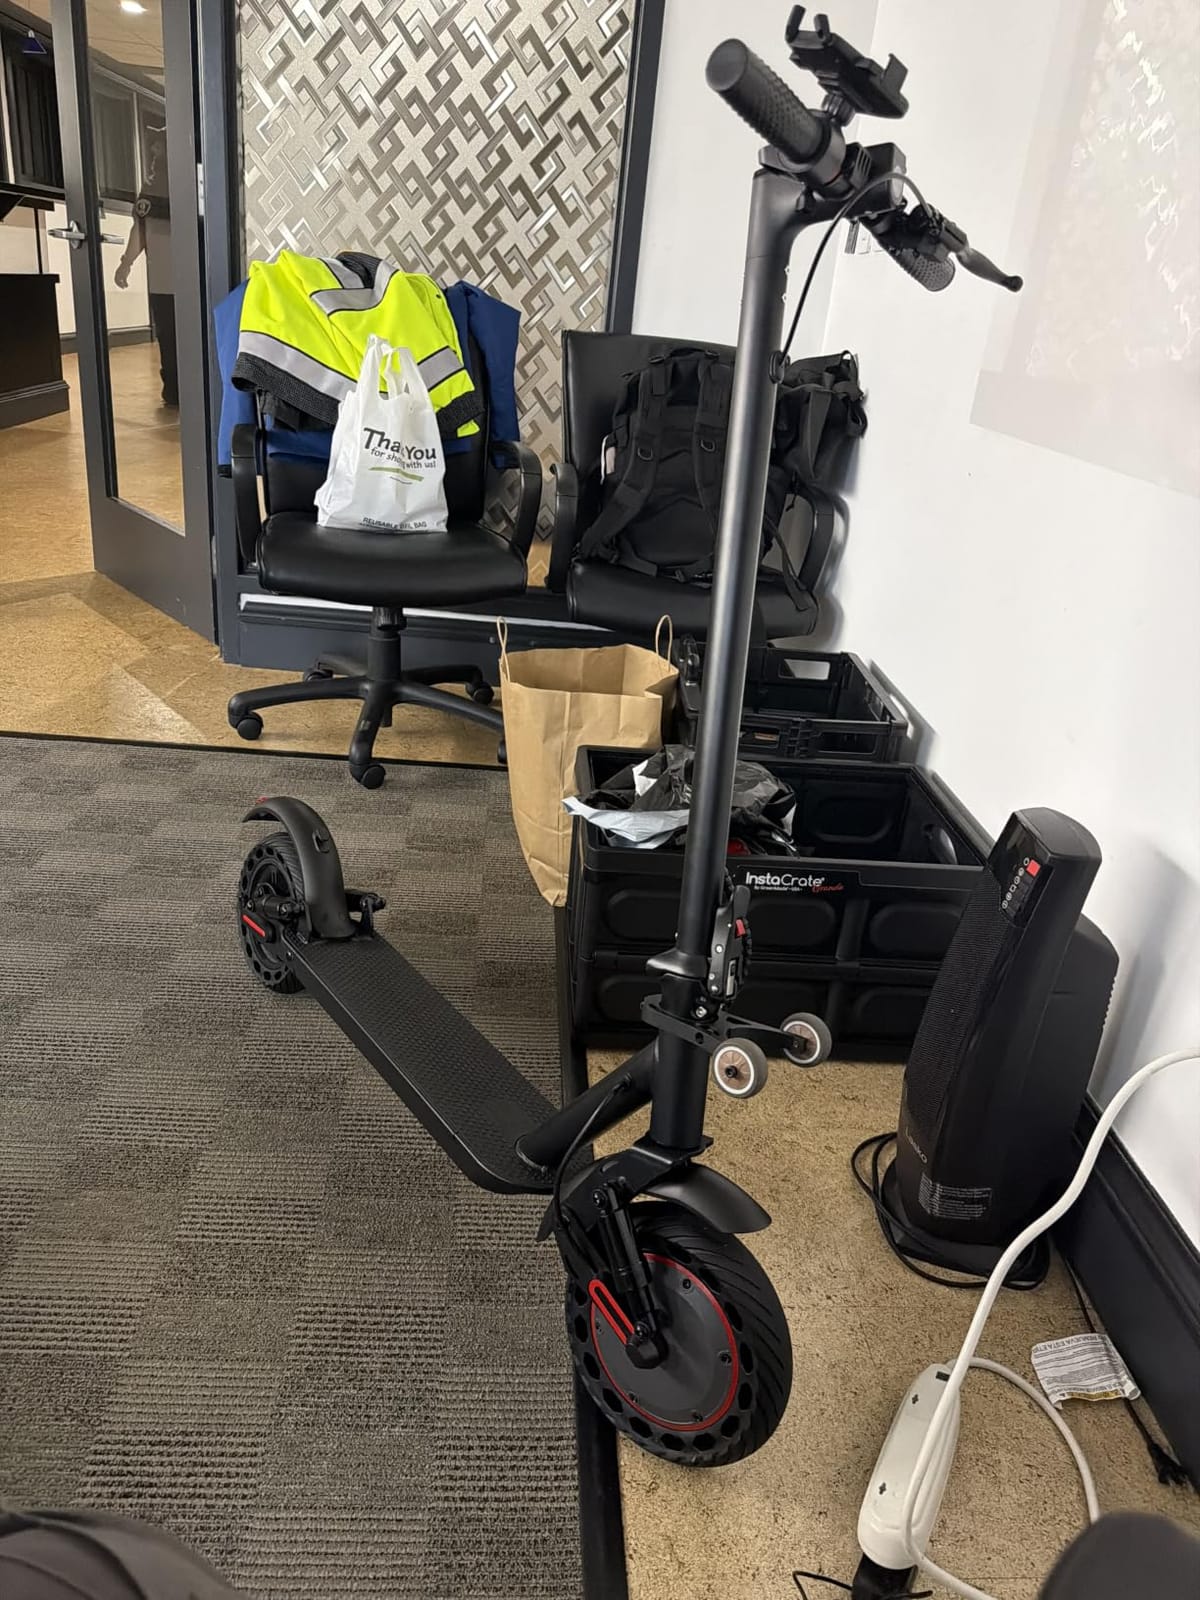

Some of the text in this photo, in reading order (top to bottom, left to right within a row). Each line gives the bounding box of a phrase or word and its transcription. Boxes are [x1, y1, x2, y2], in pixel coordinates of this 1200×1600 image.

[363, 427, 437, 461] Tha You
[370, 446, 386, 458] for
[406, 460, 422, 469] with
[413, 521, 428, 529] BAG
